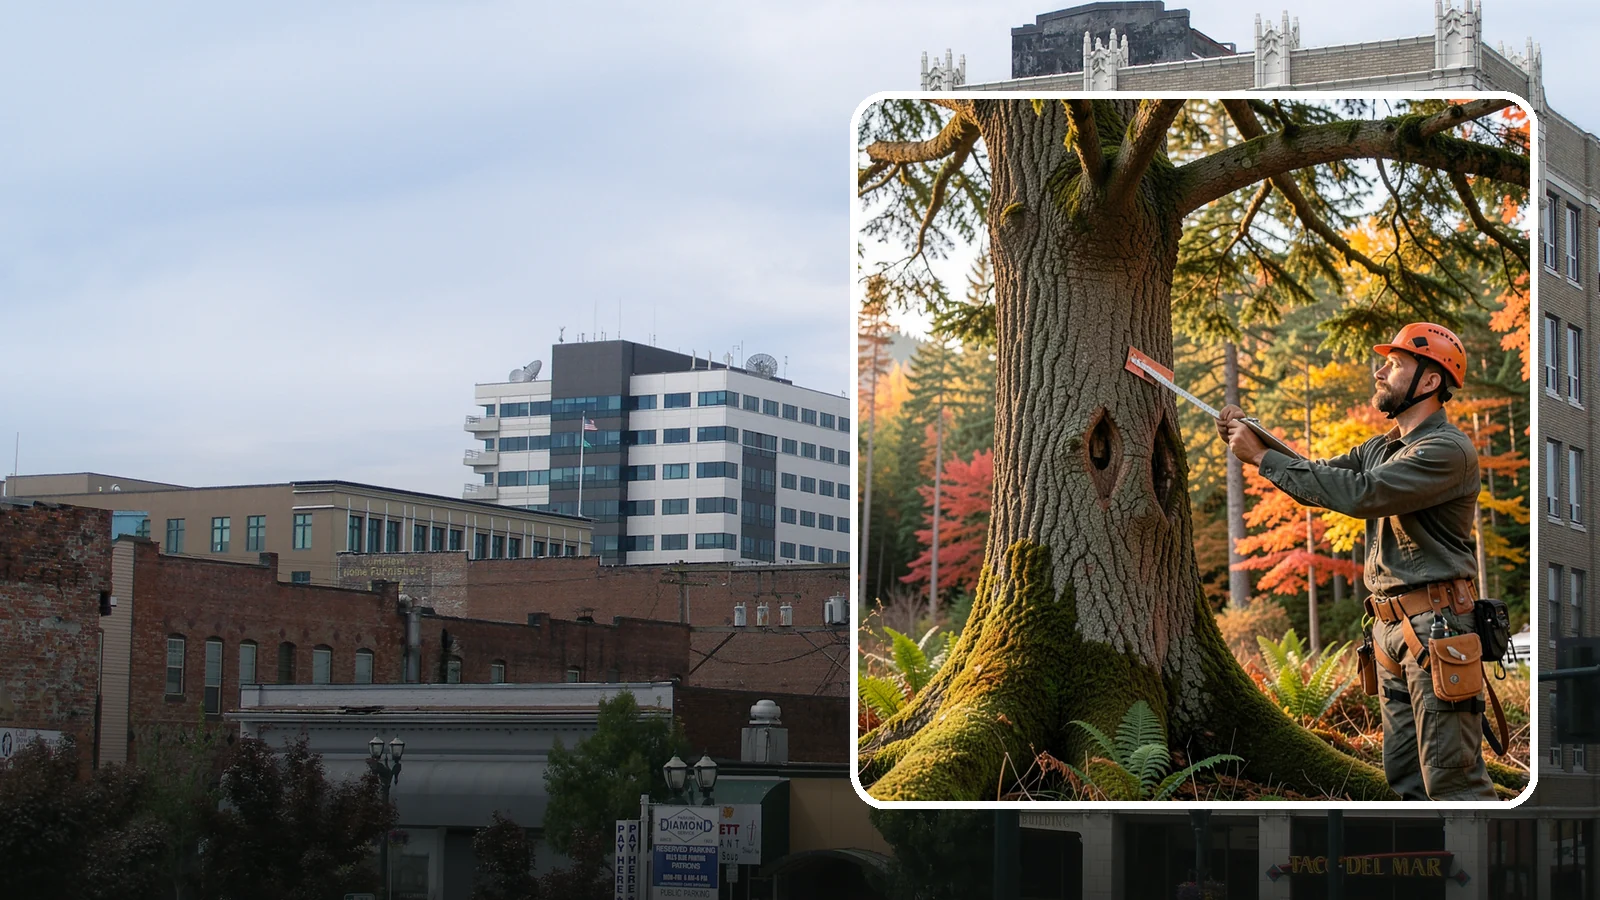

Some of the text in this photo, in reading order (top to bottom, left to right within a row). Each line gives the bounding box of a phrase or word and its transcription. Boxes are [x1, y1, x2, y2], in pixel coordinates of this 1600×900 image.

[343, 566, 427, 577] Home Furnishers
[660, 818, 713, 833] DIAMOND
[1022, 815, 1069, 827] BUILDING
[656, 845, 716, 854] RESERVED PARKING
[616, 825, 625, 893] PAY HERE
[627, 824, 637, 893] PAY HERE
[721, 851, 739, 863] Soup
[671, 861, 701, 870] PATRONS
[1289, 855, 1442, 877] TAC DEL MAR
[660, 888, 710, 899] PUBLIC PARKING
